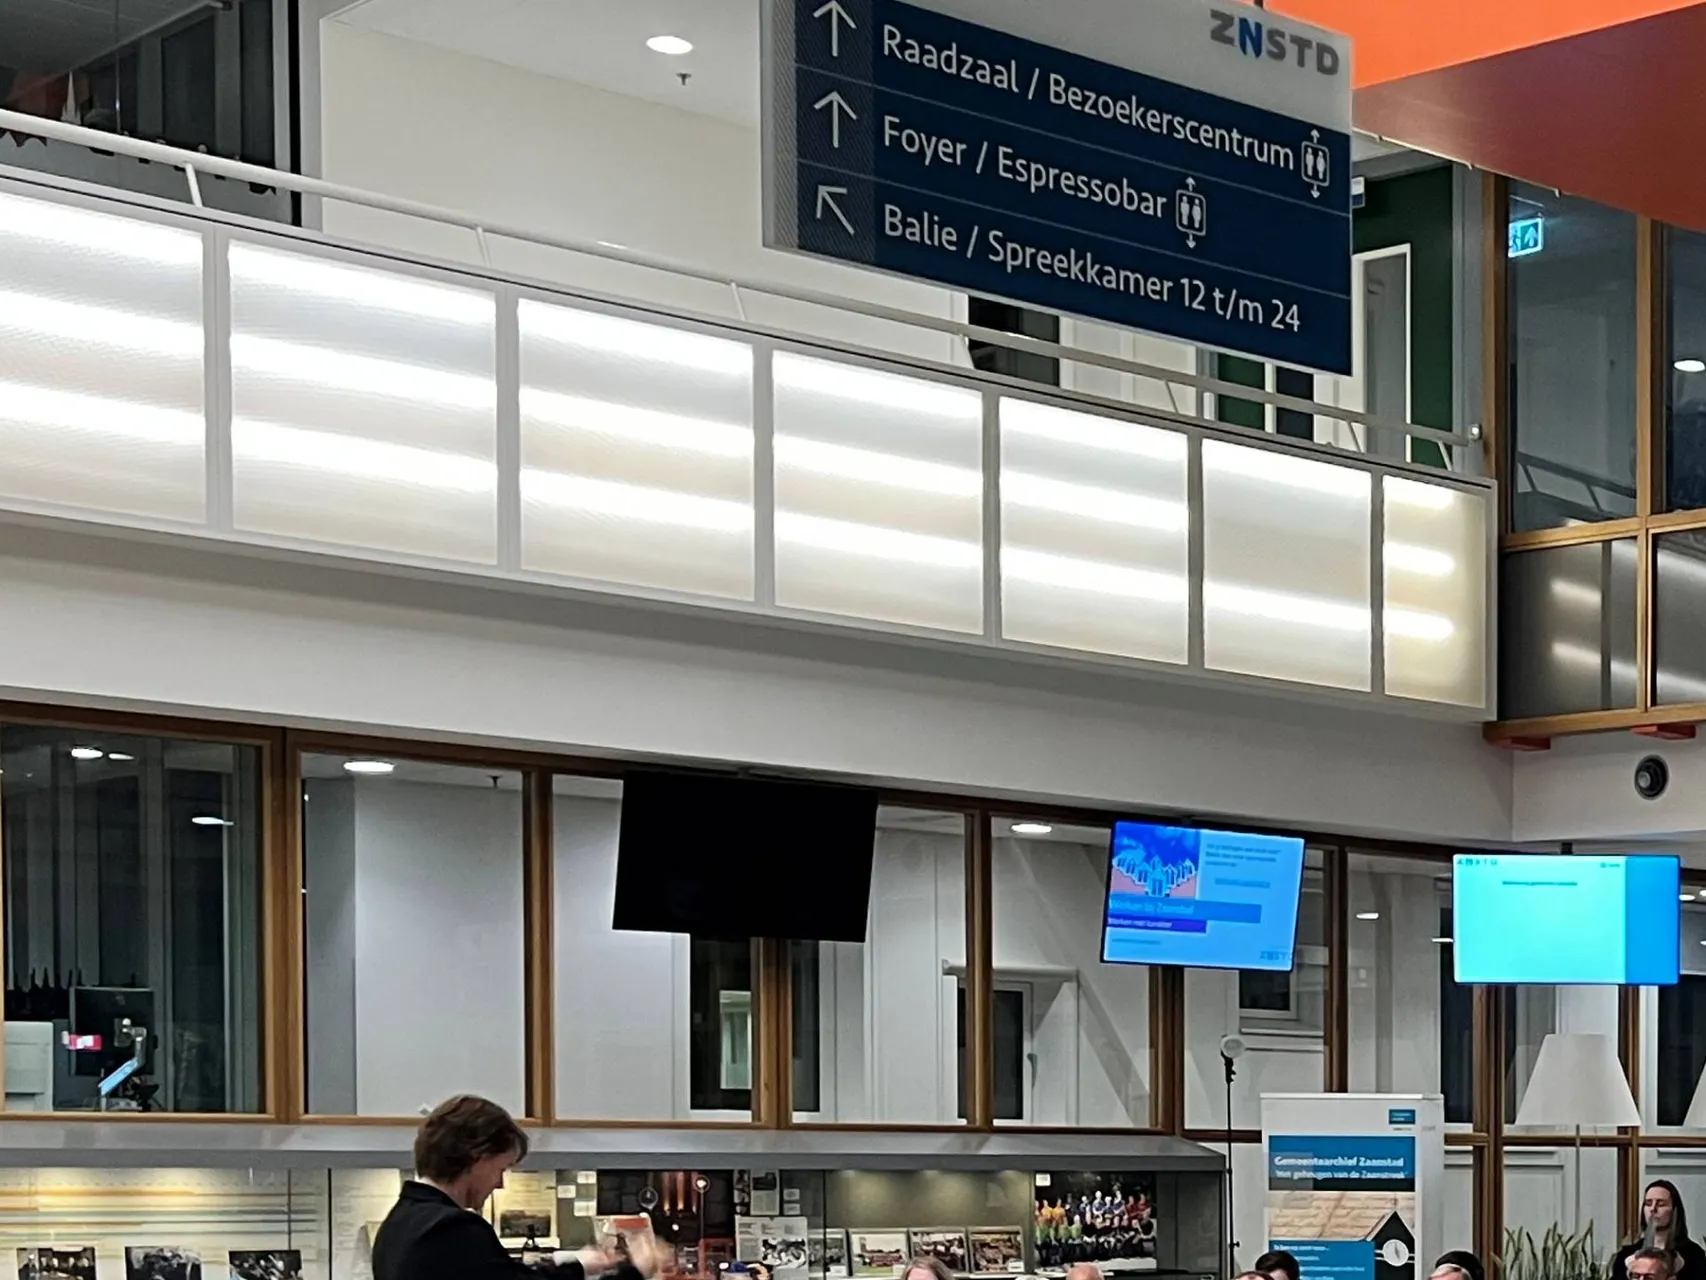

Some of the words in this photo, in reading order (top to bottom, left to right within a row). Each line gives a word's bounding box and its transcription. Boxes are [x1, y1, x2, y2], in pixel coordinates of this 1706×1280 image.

[1210, 9, 1339, 75] ZNSTD
[883, 24, 1019, 93] Raadzaal
[1028, 68, 1039, 100] /
[1050, 72, 1294, 170] Bezoekerscentrum
[884, 115, 967, 166] Foyer
[976, 141, 988, 174] /
[998, 145, 1167, 218] Espressobar
[885, 204, 957, 251] Balie
[966, 225, 979, 259] /
[988, 230, 1173, 303] Spreekkamer
[1180, 277, 1206, 312] 12
[1213, 287, 1263, 324] t/m
[1271, 299, 1300, 333] 24
[1358, 1157, 1404, 1168] Zaanstad
